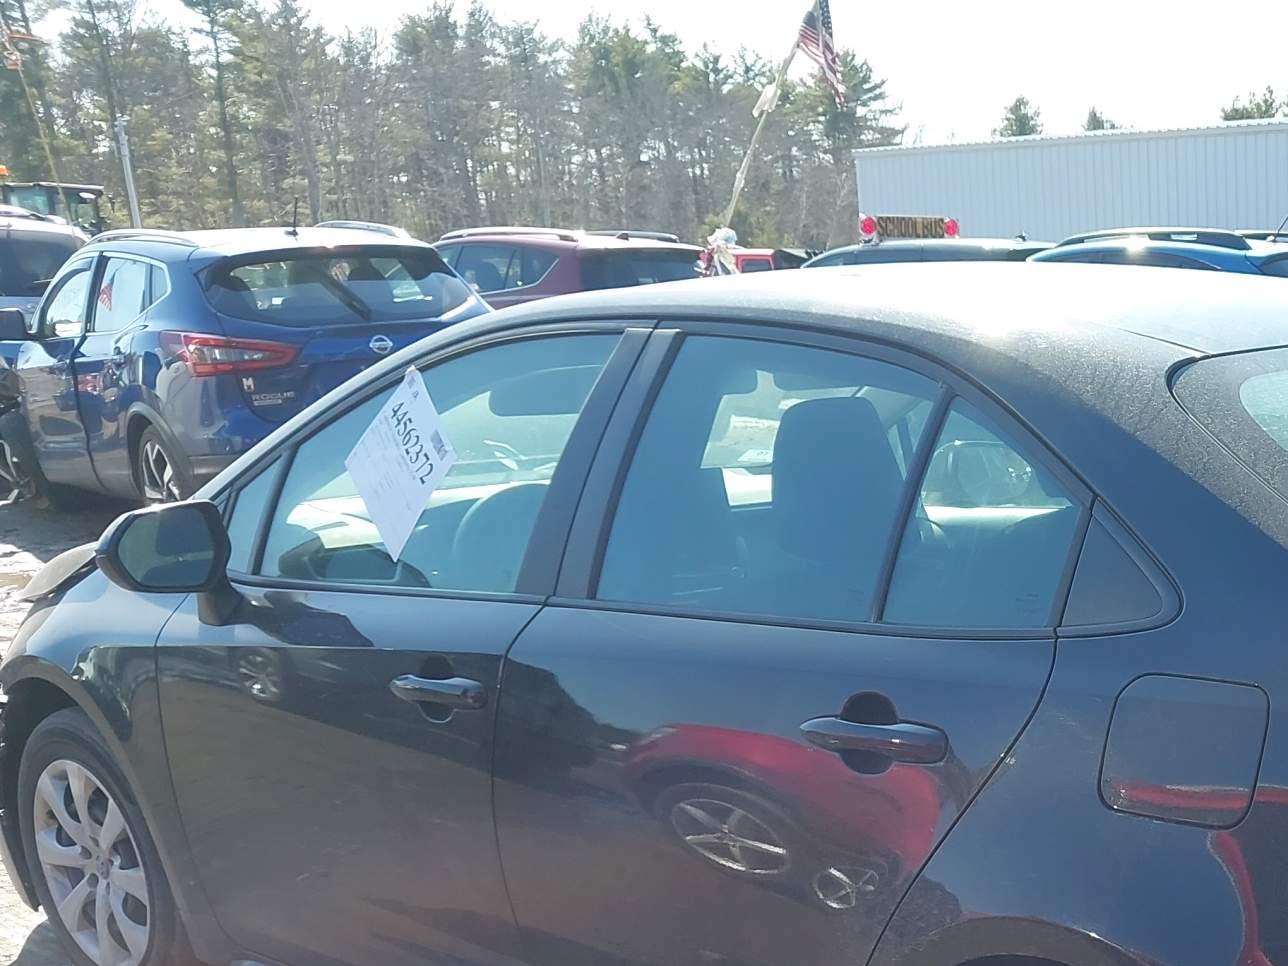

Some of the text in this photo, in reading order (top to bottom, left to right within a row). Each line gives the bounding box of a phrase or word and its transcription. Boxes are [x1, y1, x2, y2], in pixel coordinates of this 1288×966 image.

[877, 216, 945, 238] SCHOOL BUS
[391, 401, 434, 485] 44562372
